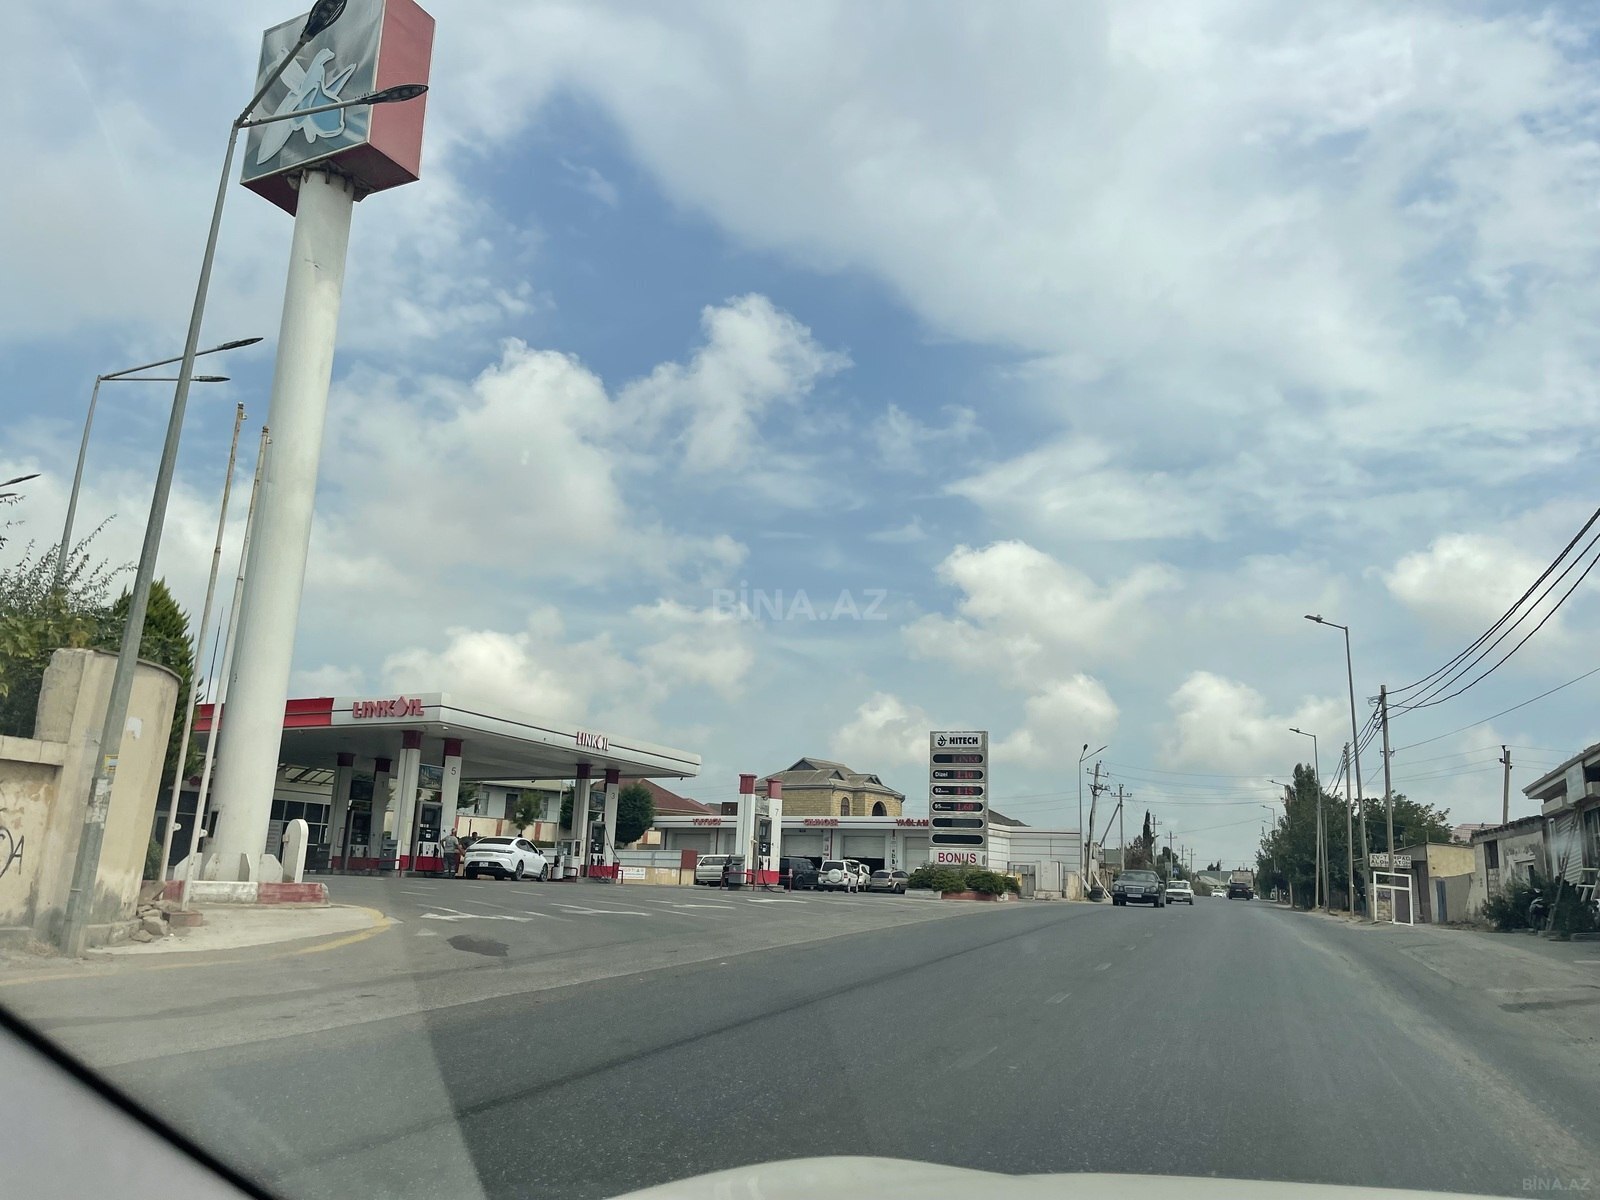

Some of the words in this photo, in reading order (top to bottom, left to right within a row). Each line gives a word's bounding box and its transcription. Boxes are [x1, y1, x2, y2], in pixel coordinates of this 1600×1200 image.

[451, 767, 457, 775] 5
[775, 808, 779, 816] 7
[938, 852, 977, 863] BONUS
